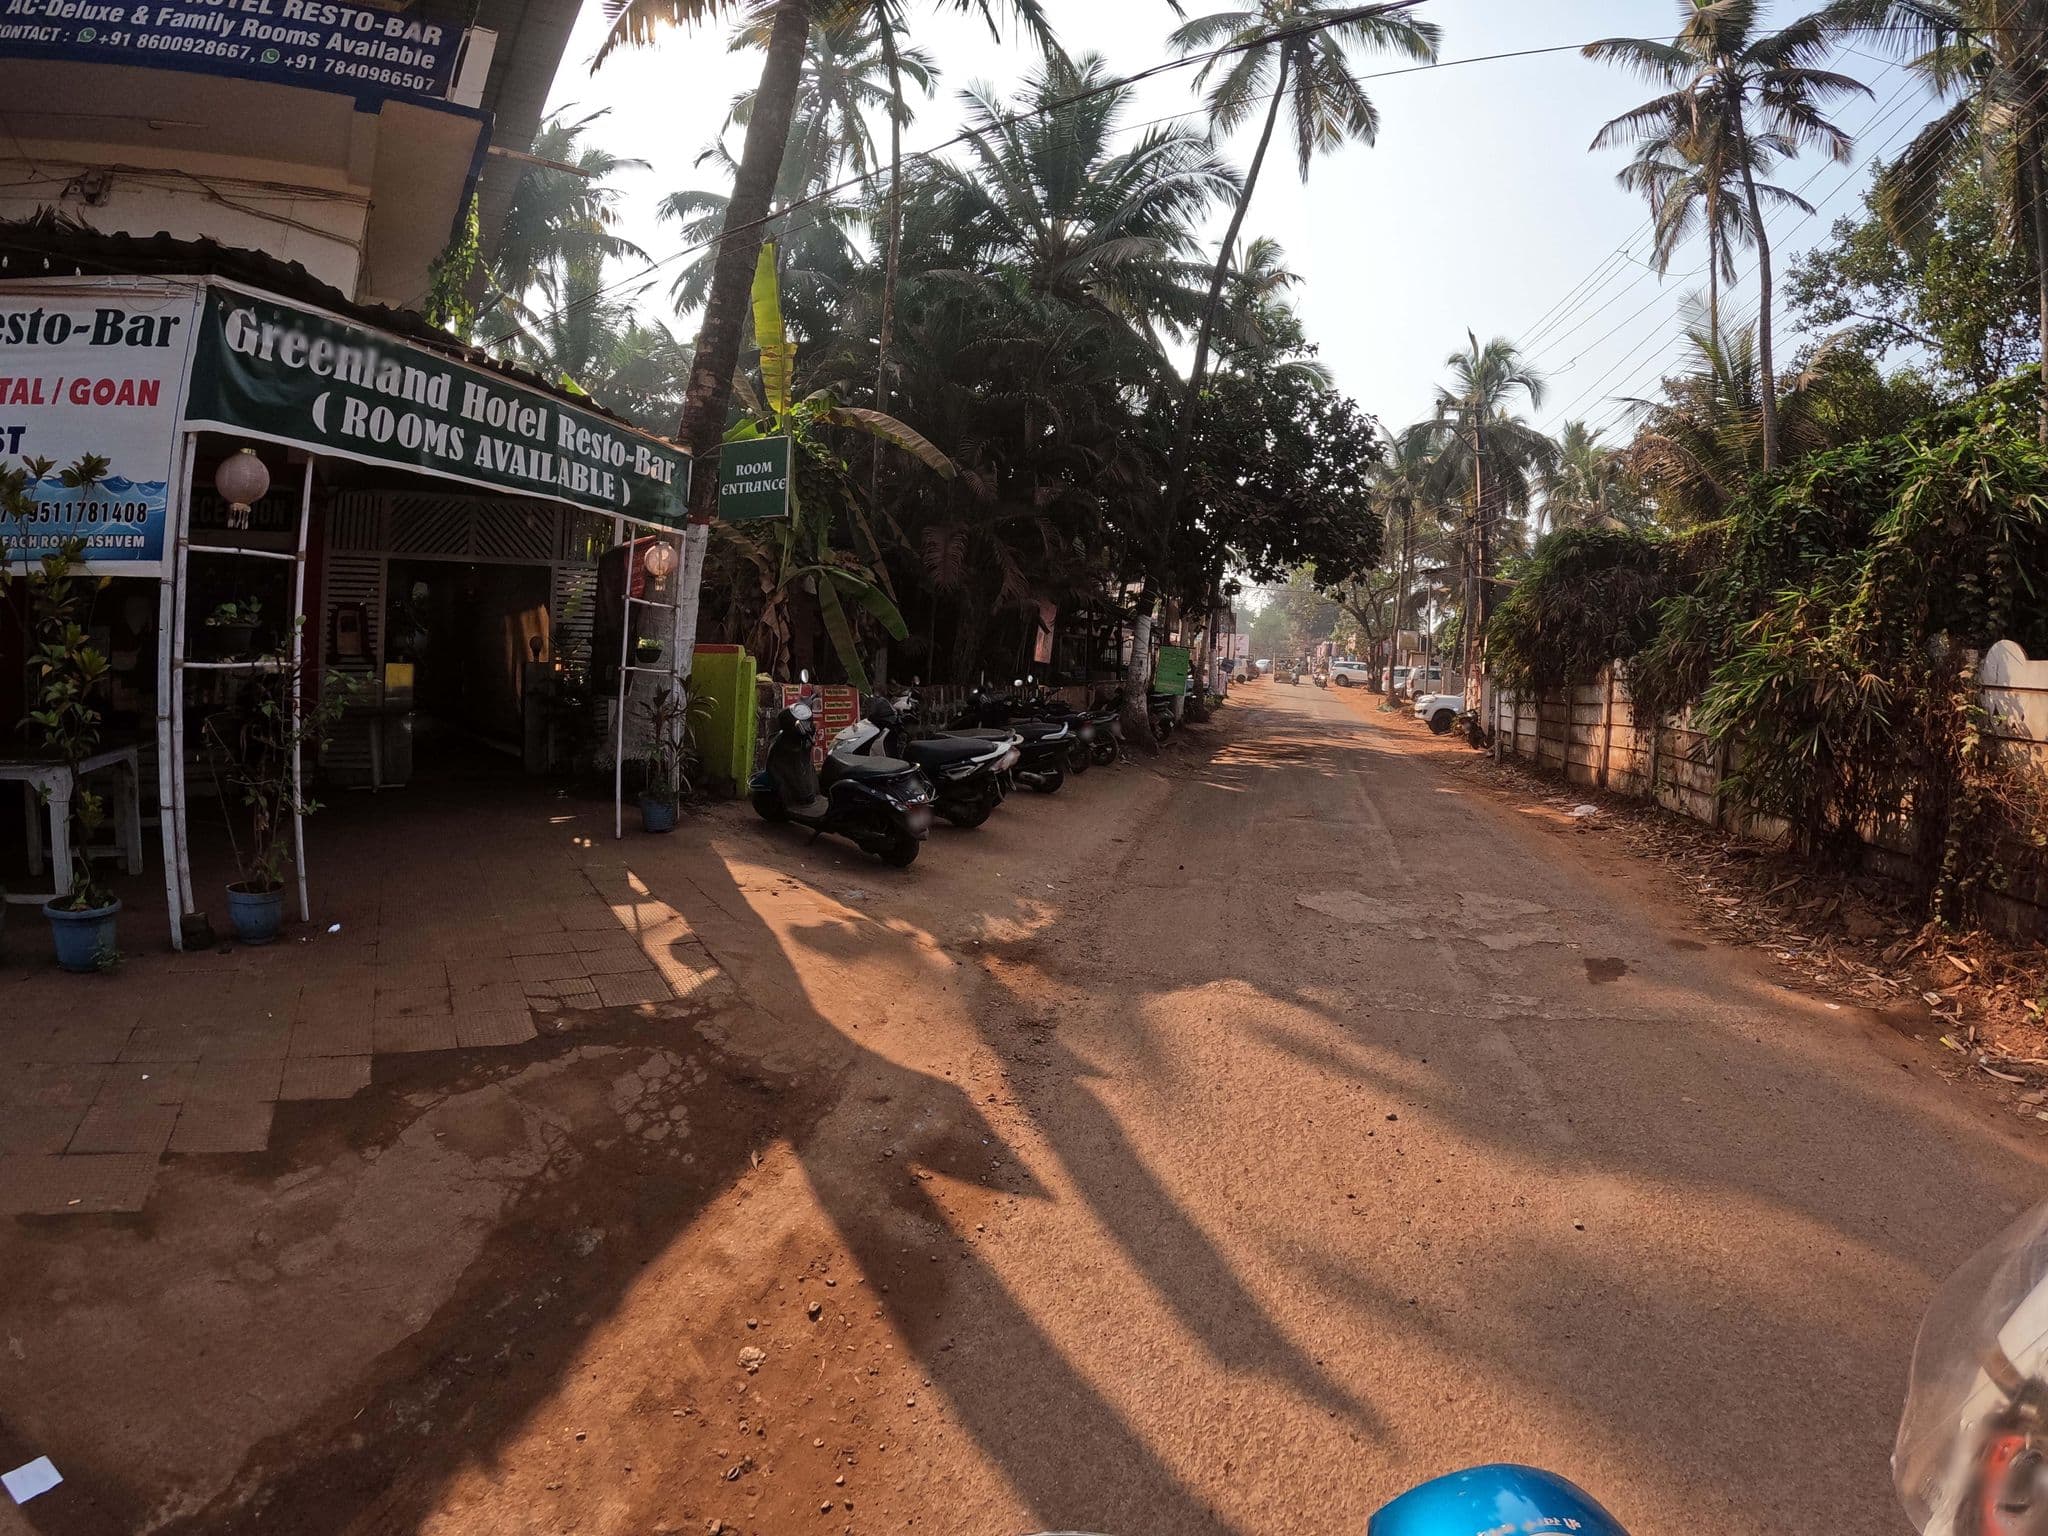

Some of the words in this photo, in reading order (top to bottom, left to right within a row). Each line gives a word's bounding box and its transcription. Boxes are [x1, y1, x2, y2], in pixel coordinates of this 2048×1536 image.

[6, 0, 125, 22] AC-Deluxe
[130, 5, 149, 25] &
[155, 7, 236, 38] Family
[240, 18, 321, 47] Rooms
[326, 32, 436, 70] Available
[282, 0, 443, 46] RESTO-BAR
[98, 31, 131, 47] +91
[136, 33, 256, 63] 8600928667,
[284, 54, 317, 71] +91
[323, 58, 436, 92] 7840986507
[69, 378, 161, 407] GOAN
[224, 308, 452, 412] Greenland
[460, 381, 548, 442] Hotel
[557, 413, 676, 485] Resto-Bar
[340, 396, 465, 462] ROOMS
[473, 434, 615, 501] AVAILABLE
[735, 461, 773, 477] ROOM
[721, 478, 787, 496] ENTRANCE
[85, 534, 146, 548] ASHVEM
